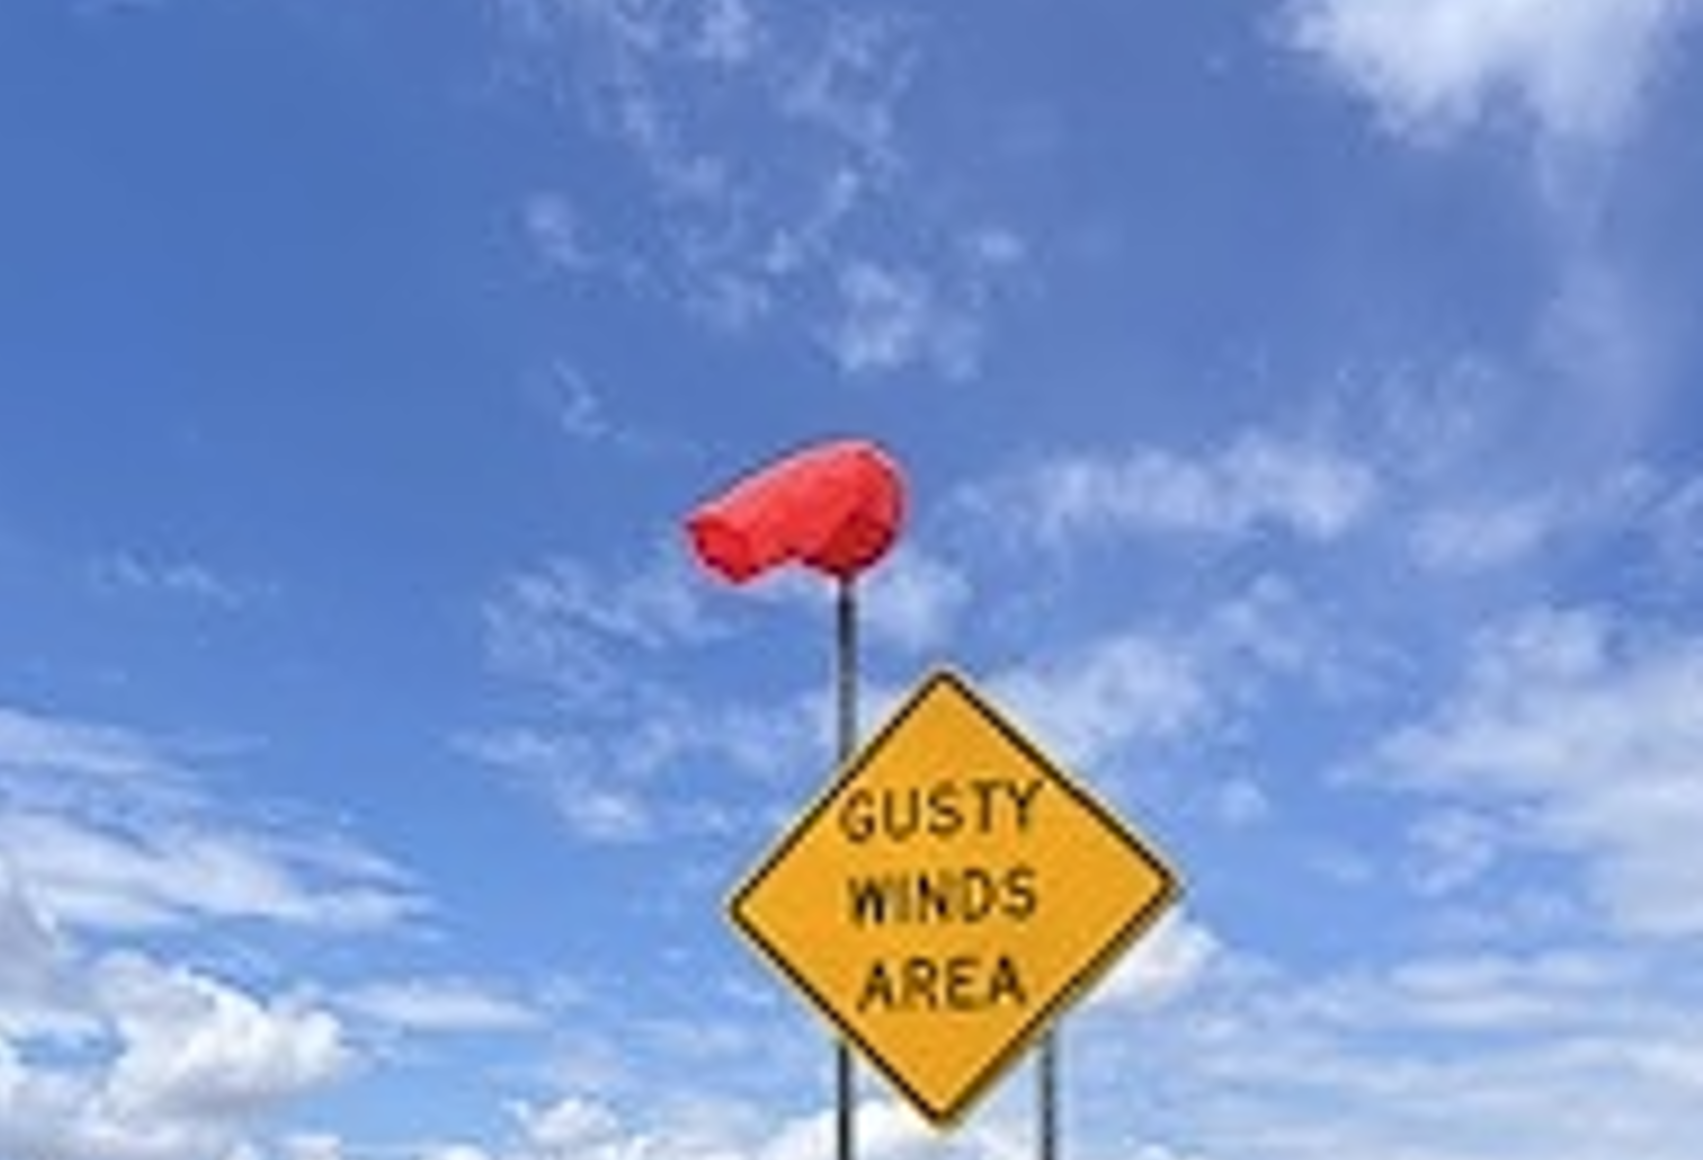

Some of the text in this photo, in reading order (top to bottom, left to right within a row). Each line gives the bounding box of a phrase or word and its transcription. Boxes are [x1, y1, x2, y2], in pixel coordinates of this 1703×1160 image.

[838, 779, 1043, 844] GUSTY
[846, 865, 1038, 928] WINDS
[857, 955, 1028, 1013] AREA
